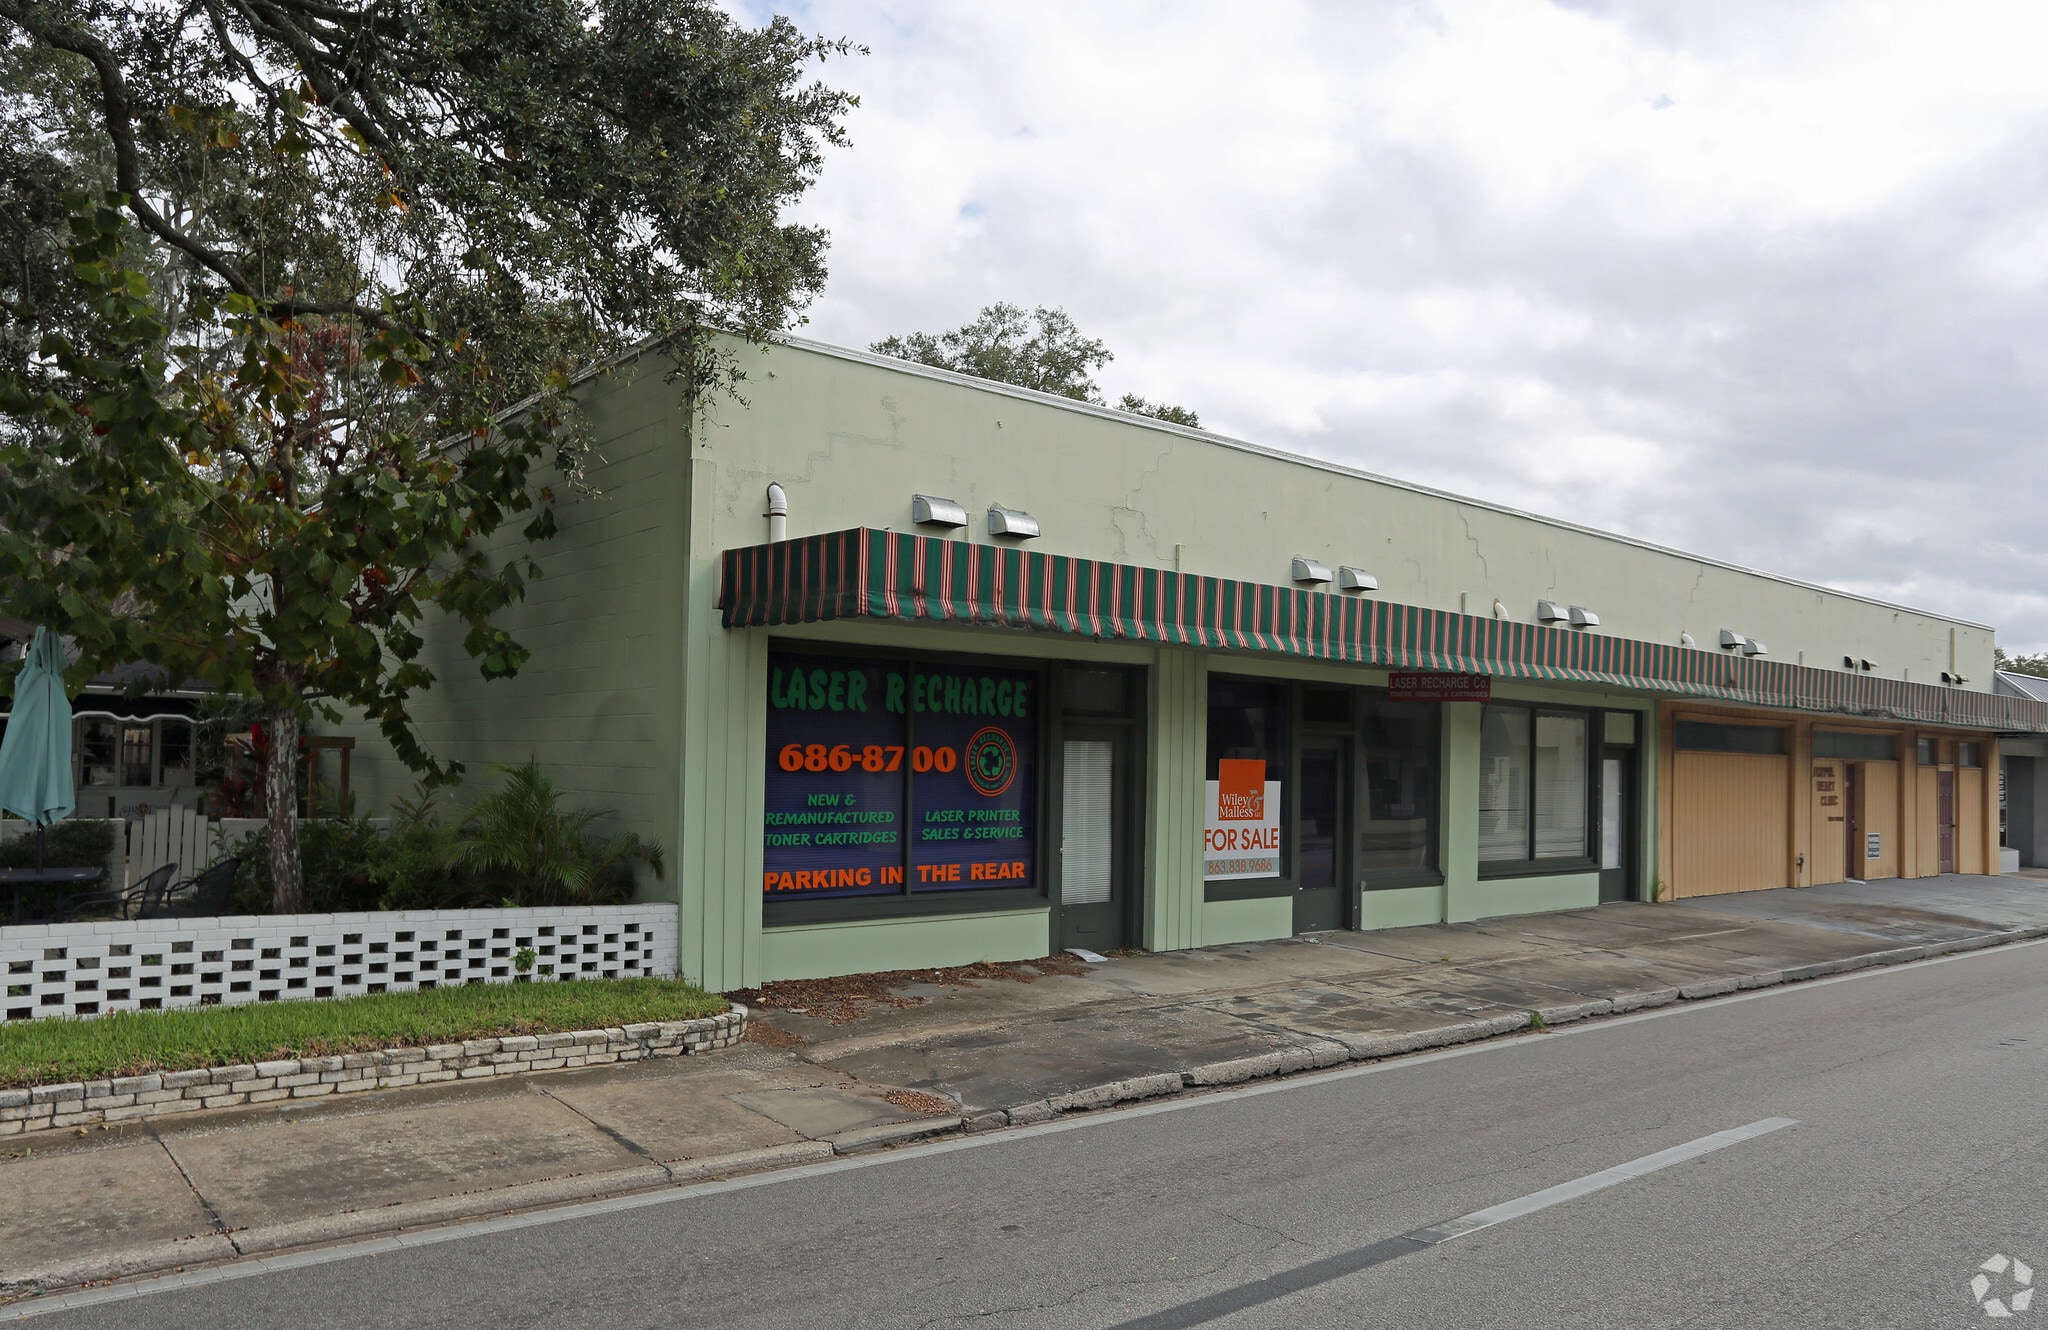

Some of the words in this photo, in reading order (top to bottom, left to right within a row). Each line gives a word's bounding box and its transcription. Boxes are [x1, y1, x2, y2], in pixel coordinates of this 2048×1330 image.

[1390, 677, 1417, 689] LASER
[1421, 676, 1469, 689] RECHARGE
[1473, 677, 1489, 689] Co.
[771, 666, 868, 713] LASER
[885, 673, 1028, 718] RECHARGE
[778, 743, 957, 773] 686-8700
[807, 794, 839, 806] NEW
[845, 793, 856, 805] &
[1222, 794, 1249, 808] Wiley
[765, 812, 895, 825] REMANUFACTURED
[925, 811, 965, 823] LASER
[968, 809, 1020, 822] PRINTER
[1220, 806, 1253, 818] Malless
[765, 832, 811, 846] TONER
[815, 831, 897, 845] CARTRIDGES
[921, 828, 959, 841] SALES
[1204, 829, 1238, 852] FOR
[1241, 828, 1279, 851] SALE
[1208, 859, 1273, 875] 863.838.9686
[763, 868, 872, 892] PARKING
[880, 866, 904, 885] IN
[917, 864, 961, 882] THE
[970, 862, 1026, 881] REAR
